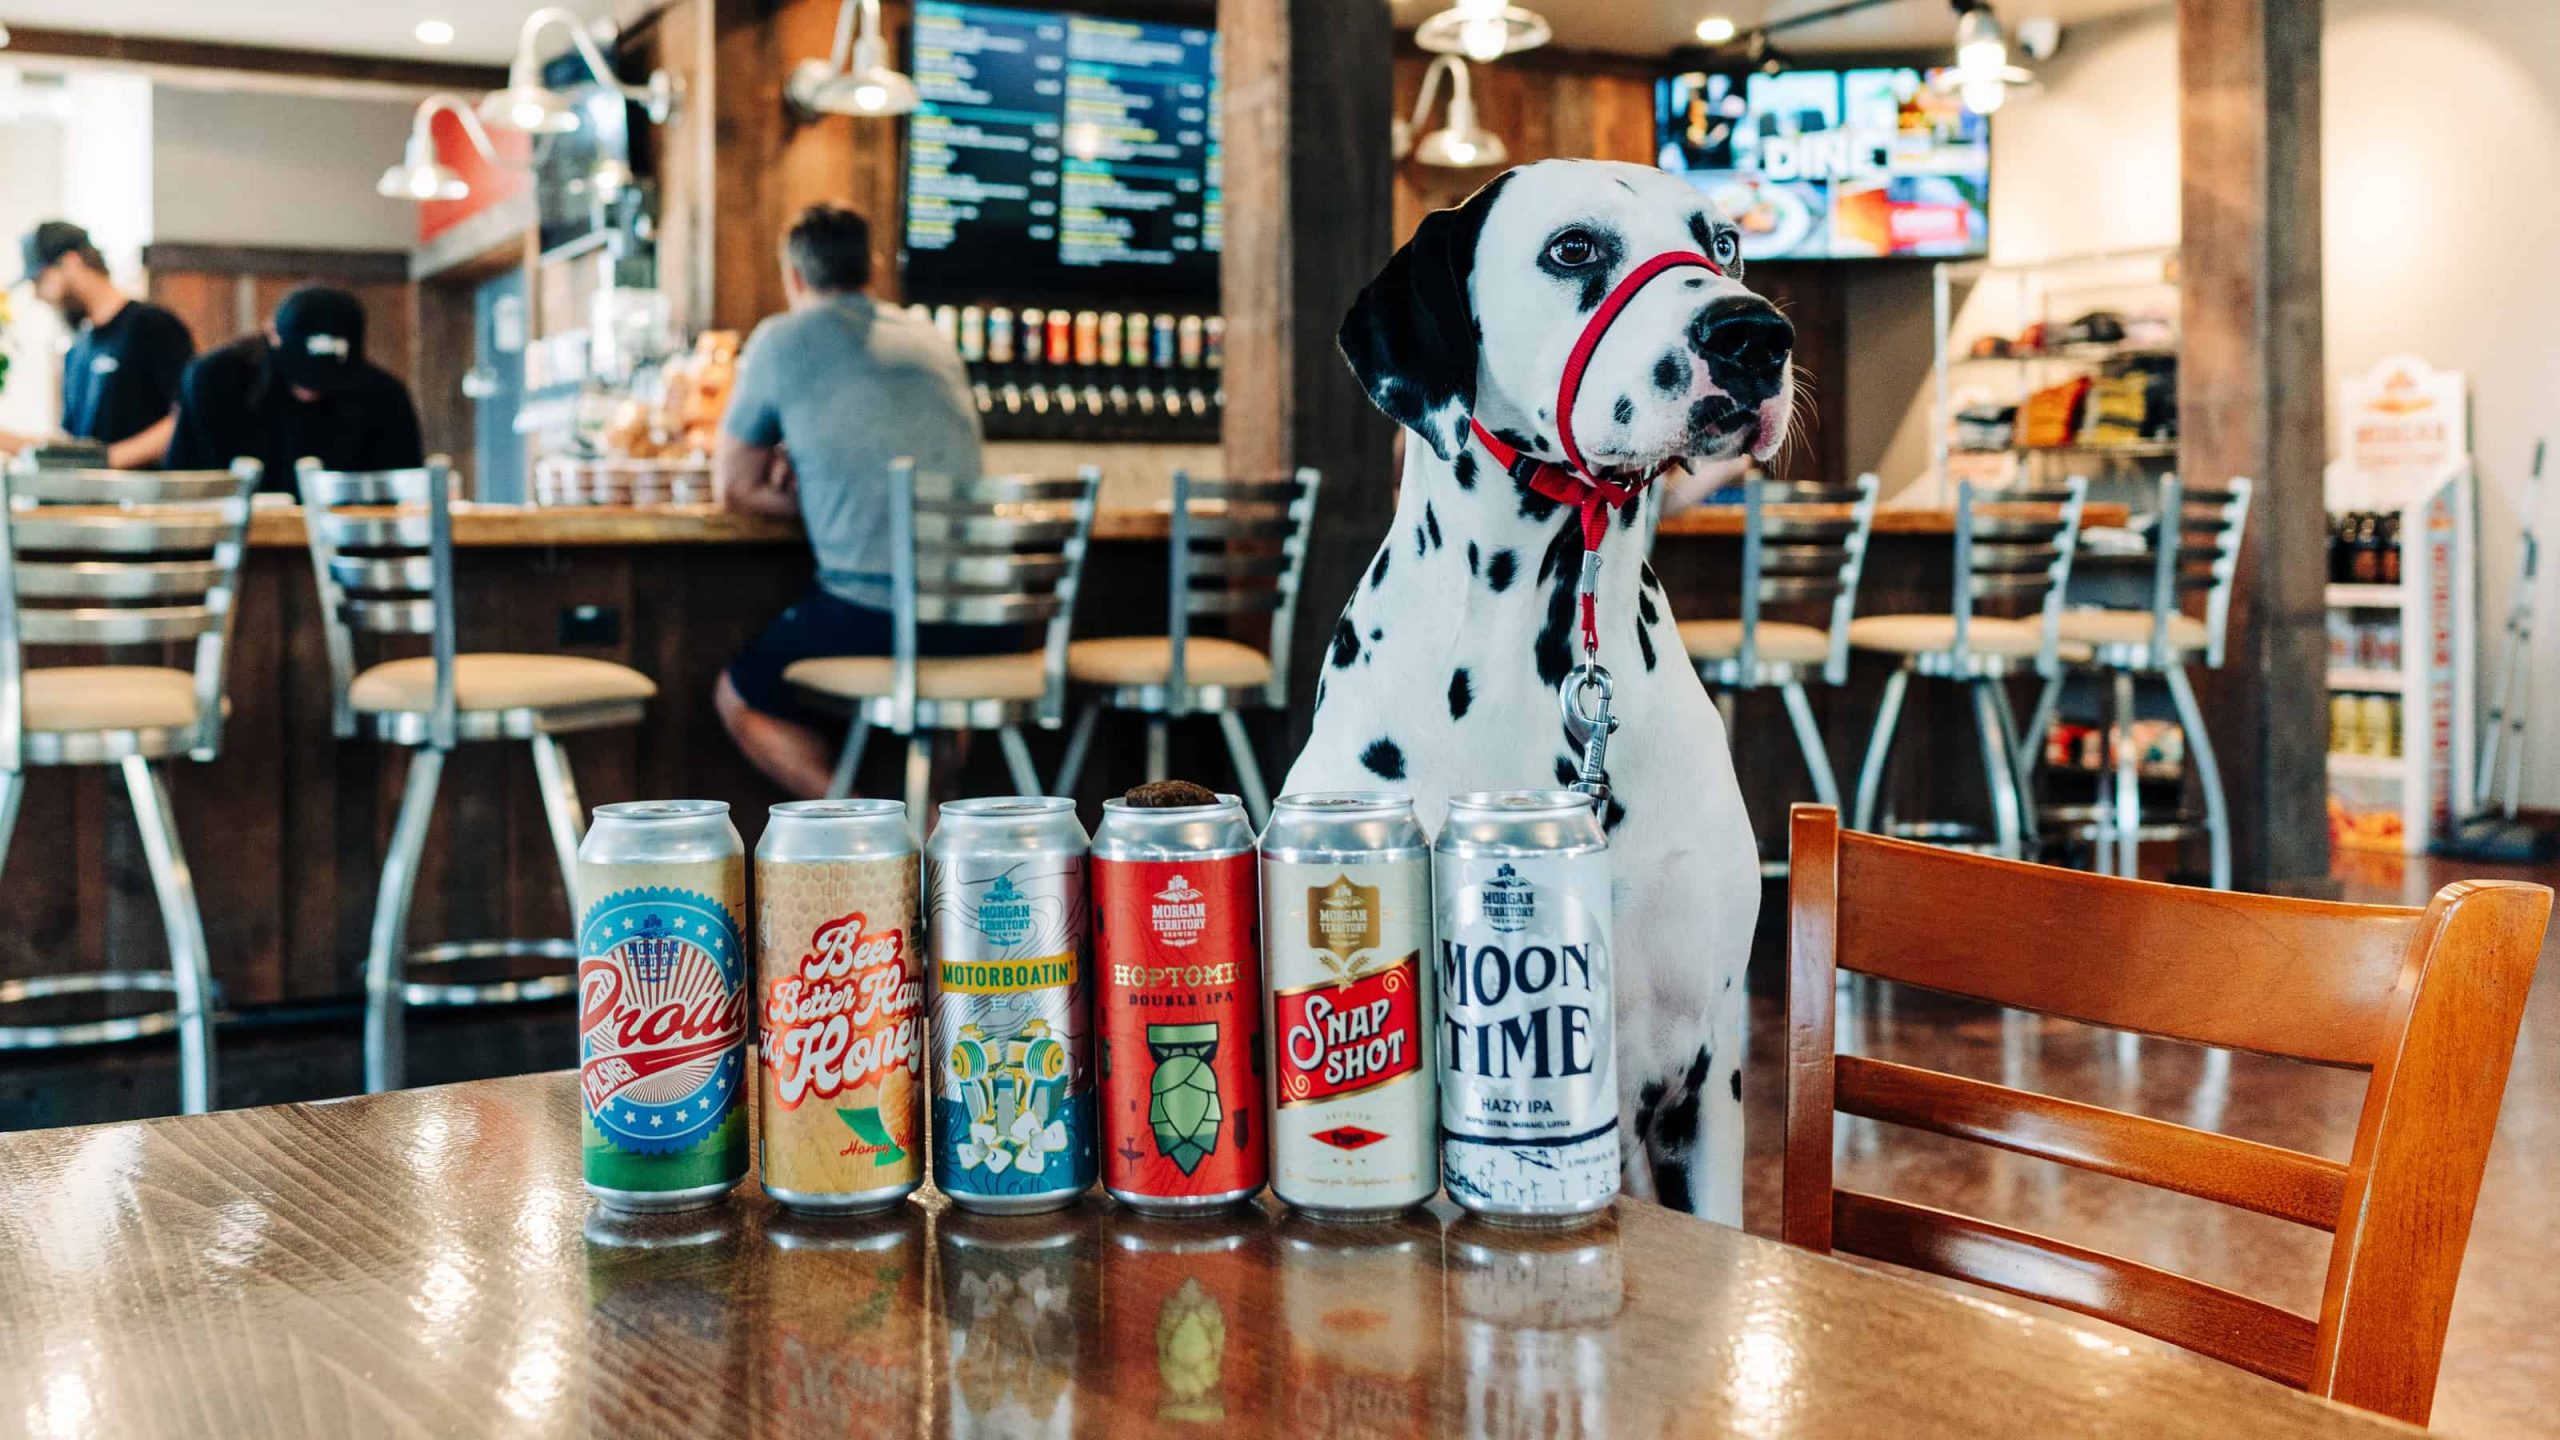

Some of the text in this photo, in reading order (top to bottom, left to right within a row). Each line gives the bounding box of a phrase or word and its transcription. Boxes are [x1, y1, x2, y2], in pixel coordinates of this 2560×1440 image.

[1482, 892, 1535, 905] MORGAN
[979, 905, 1030, 918] MORGAN
[1152, 903, 1206, 918] MORGAN
[1319, 909, 1368, 921] MORGAN
[1482, 906, 1535, 917] TERRITORY
[979, 919, 1031, 930] TERRITORY
[1152, 918, 1206, 931] TERRITORY
[628, 941, 679, 955] MORGAN
[805, 920, 898, 980] Bees
[1441, 938, 1591, 1006] MOON
[770, 979, 855, 1024] Better
[969, 996, 1040, 1013] IPA
[1129, 991, 1234, 1007] DOUBLE IPA
[1288, 995, 1391, 1071] SNAP
[1444, 1005, 1594, 1079] TIME
[760, 1014, 922, 1103] My Honey
[1324, 1028, 1406, 1085] SHOT
[587, 1056, 640, 1101] PILSNER
[1481, 1098, 1554, 1113] HAZY IPA
[840, 1140, 890, 1156] Honey
